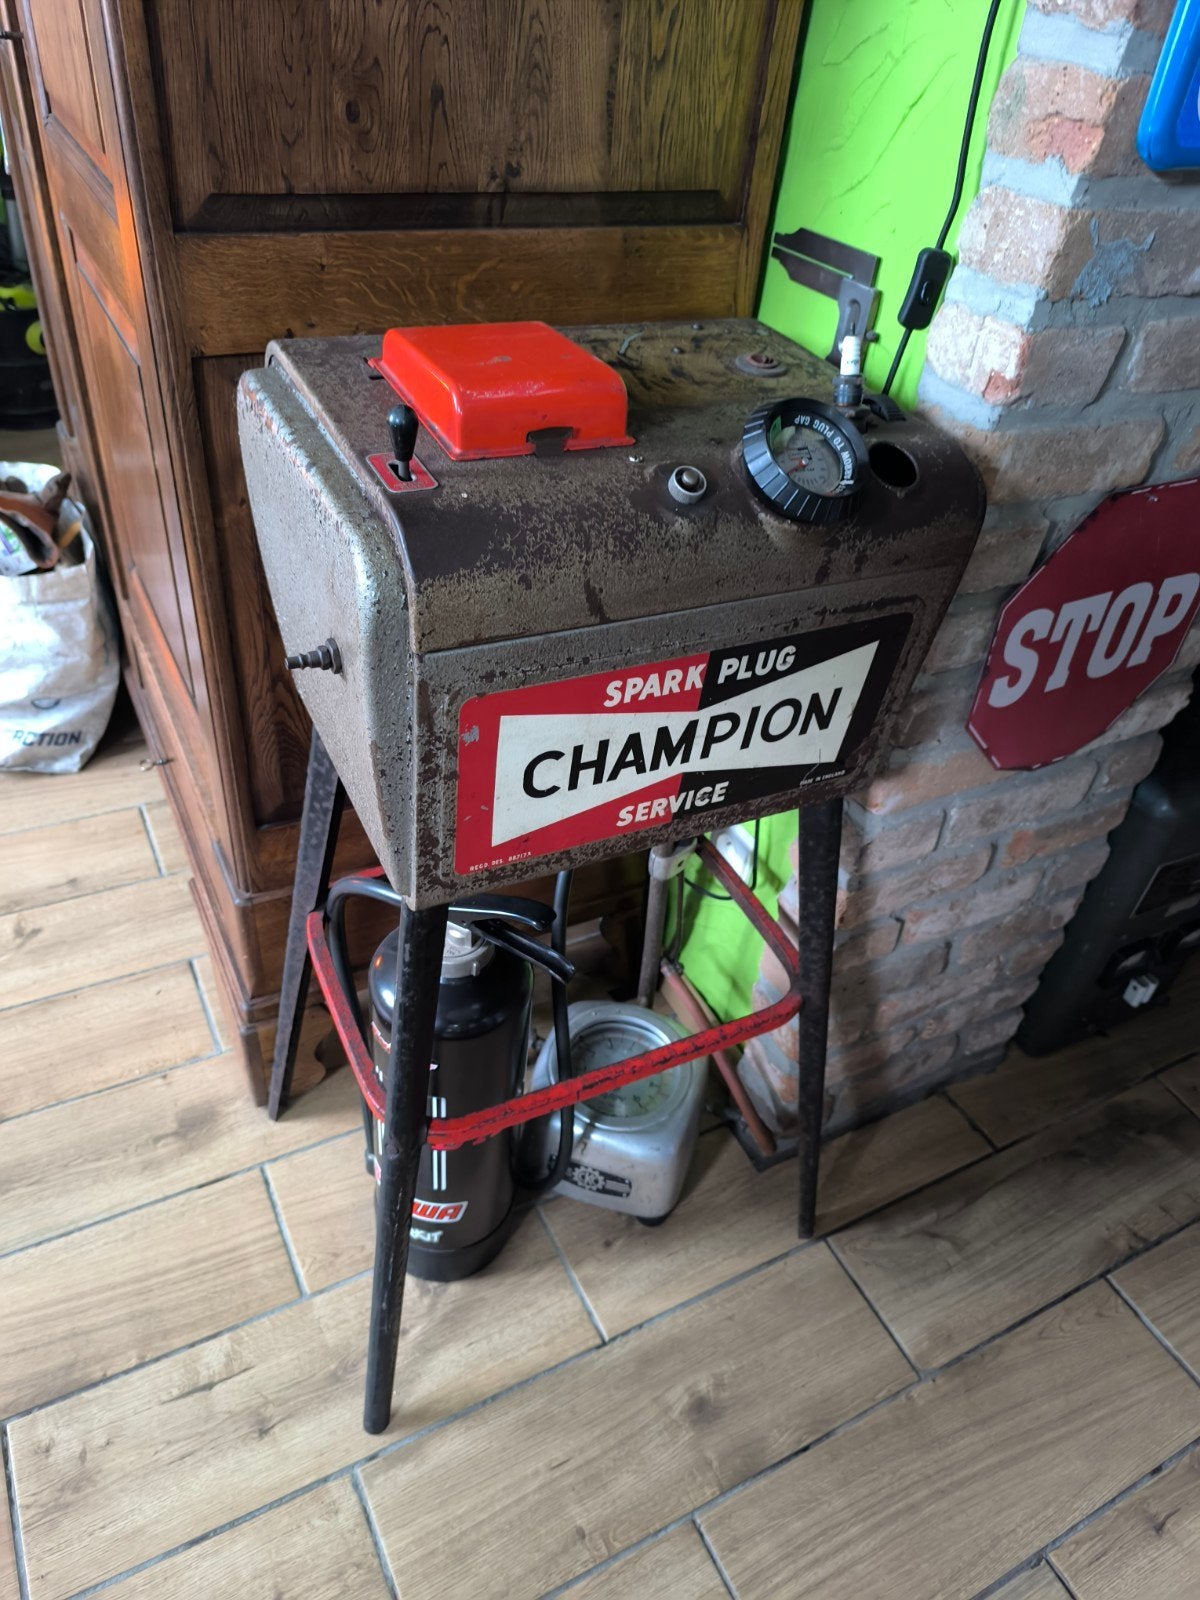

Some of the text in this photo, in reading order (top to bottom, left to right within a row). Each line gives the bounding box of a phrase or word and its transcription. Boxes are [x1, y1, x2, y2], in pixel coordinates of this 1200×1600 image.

[794, 414, 812, 426] GAP
[812, 419, 835, 438] PLUG
[833, 437, 846, 451] TO
[988, 572, 1200, 709] STOP
[603, 644, 797, 708] SPARK PLUG
[522, 687, 843, 799] CHAMPION
[616, 781, 729, 827] SERVICE
